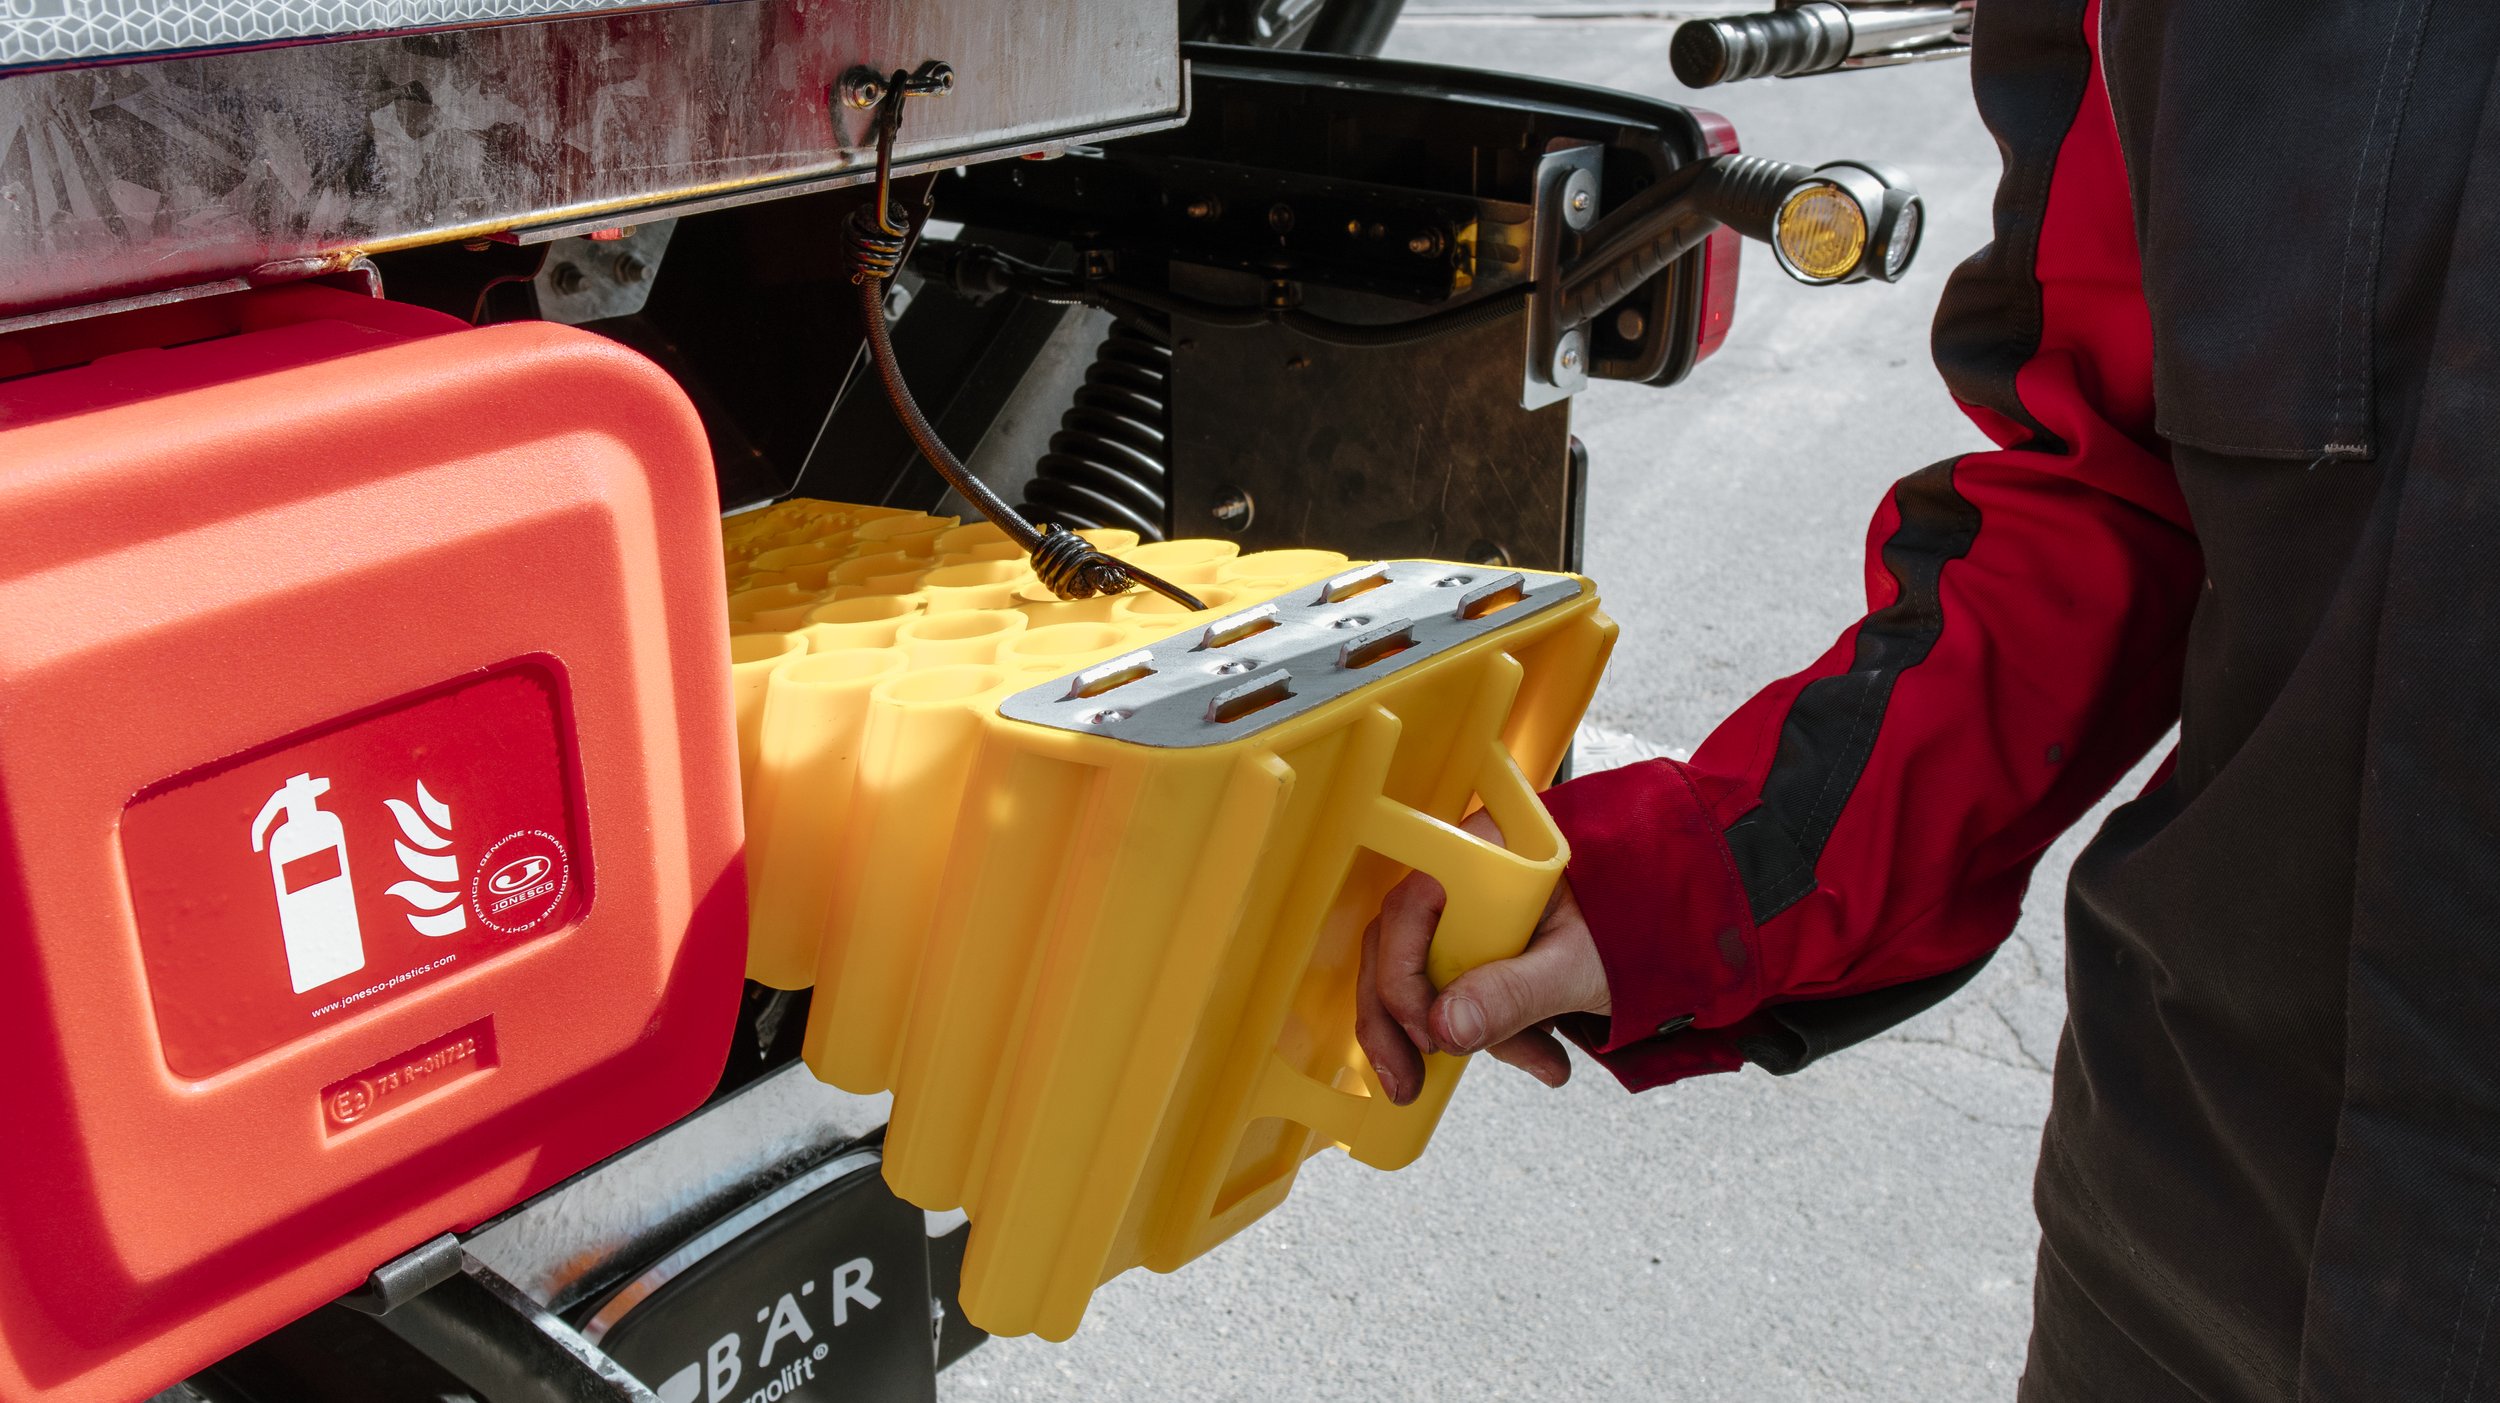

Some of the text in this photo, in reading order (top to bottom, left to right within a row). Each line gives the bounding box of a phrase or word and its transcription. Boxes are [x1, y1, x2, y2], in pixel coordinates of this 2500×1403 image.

[480, 830, 525, 867] GENUINE
[534, 830, 568, 862] GARANTI
[471, 876, 500, 931] AUTENTICO
[492, 882, 554, 912] JONESCO
[507, 920, 536, 934] ECHT
[311, 953, 457, 1018] www.jonesco-plastics.com
[334, 1087, 370, 1120] E2
[378, 1072, 399, 1095] 73
[707, 1257, 882, 1403] BÄR
